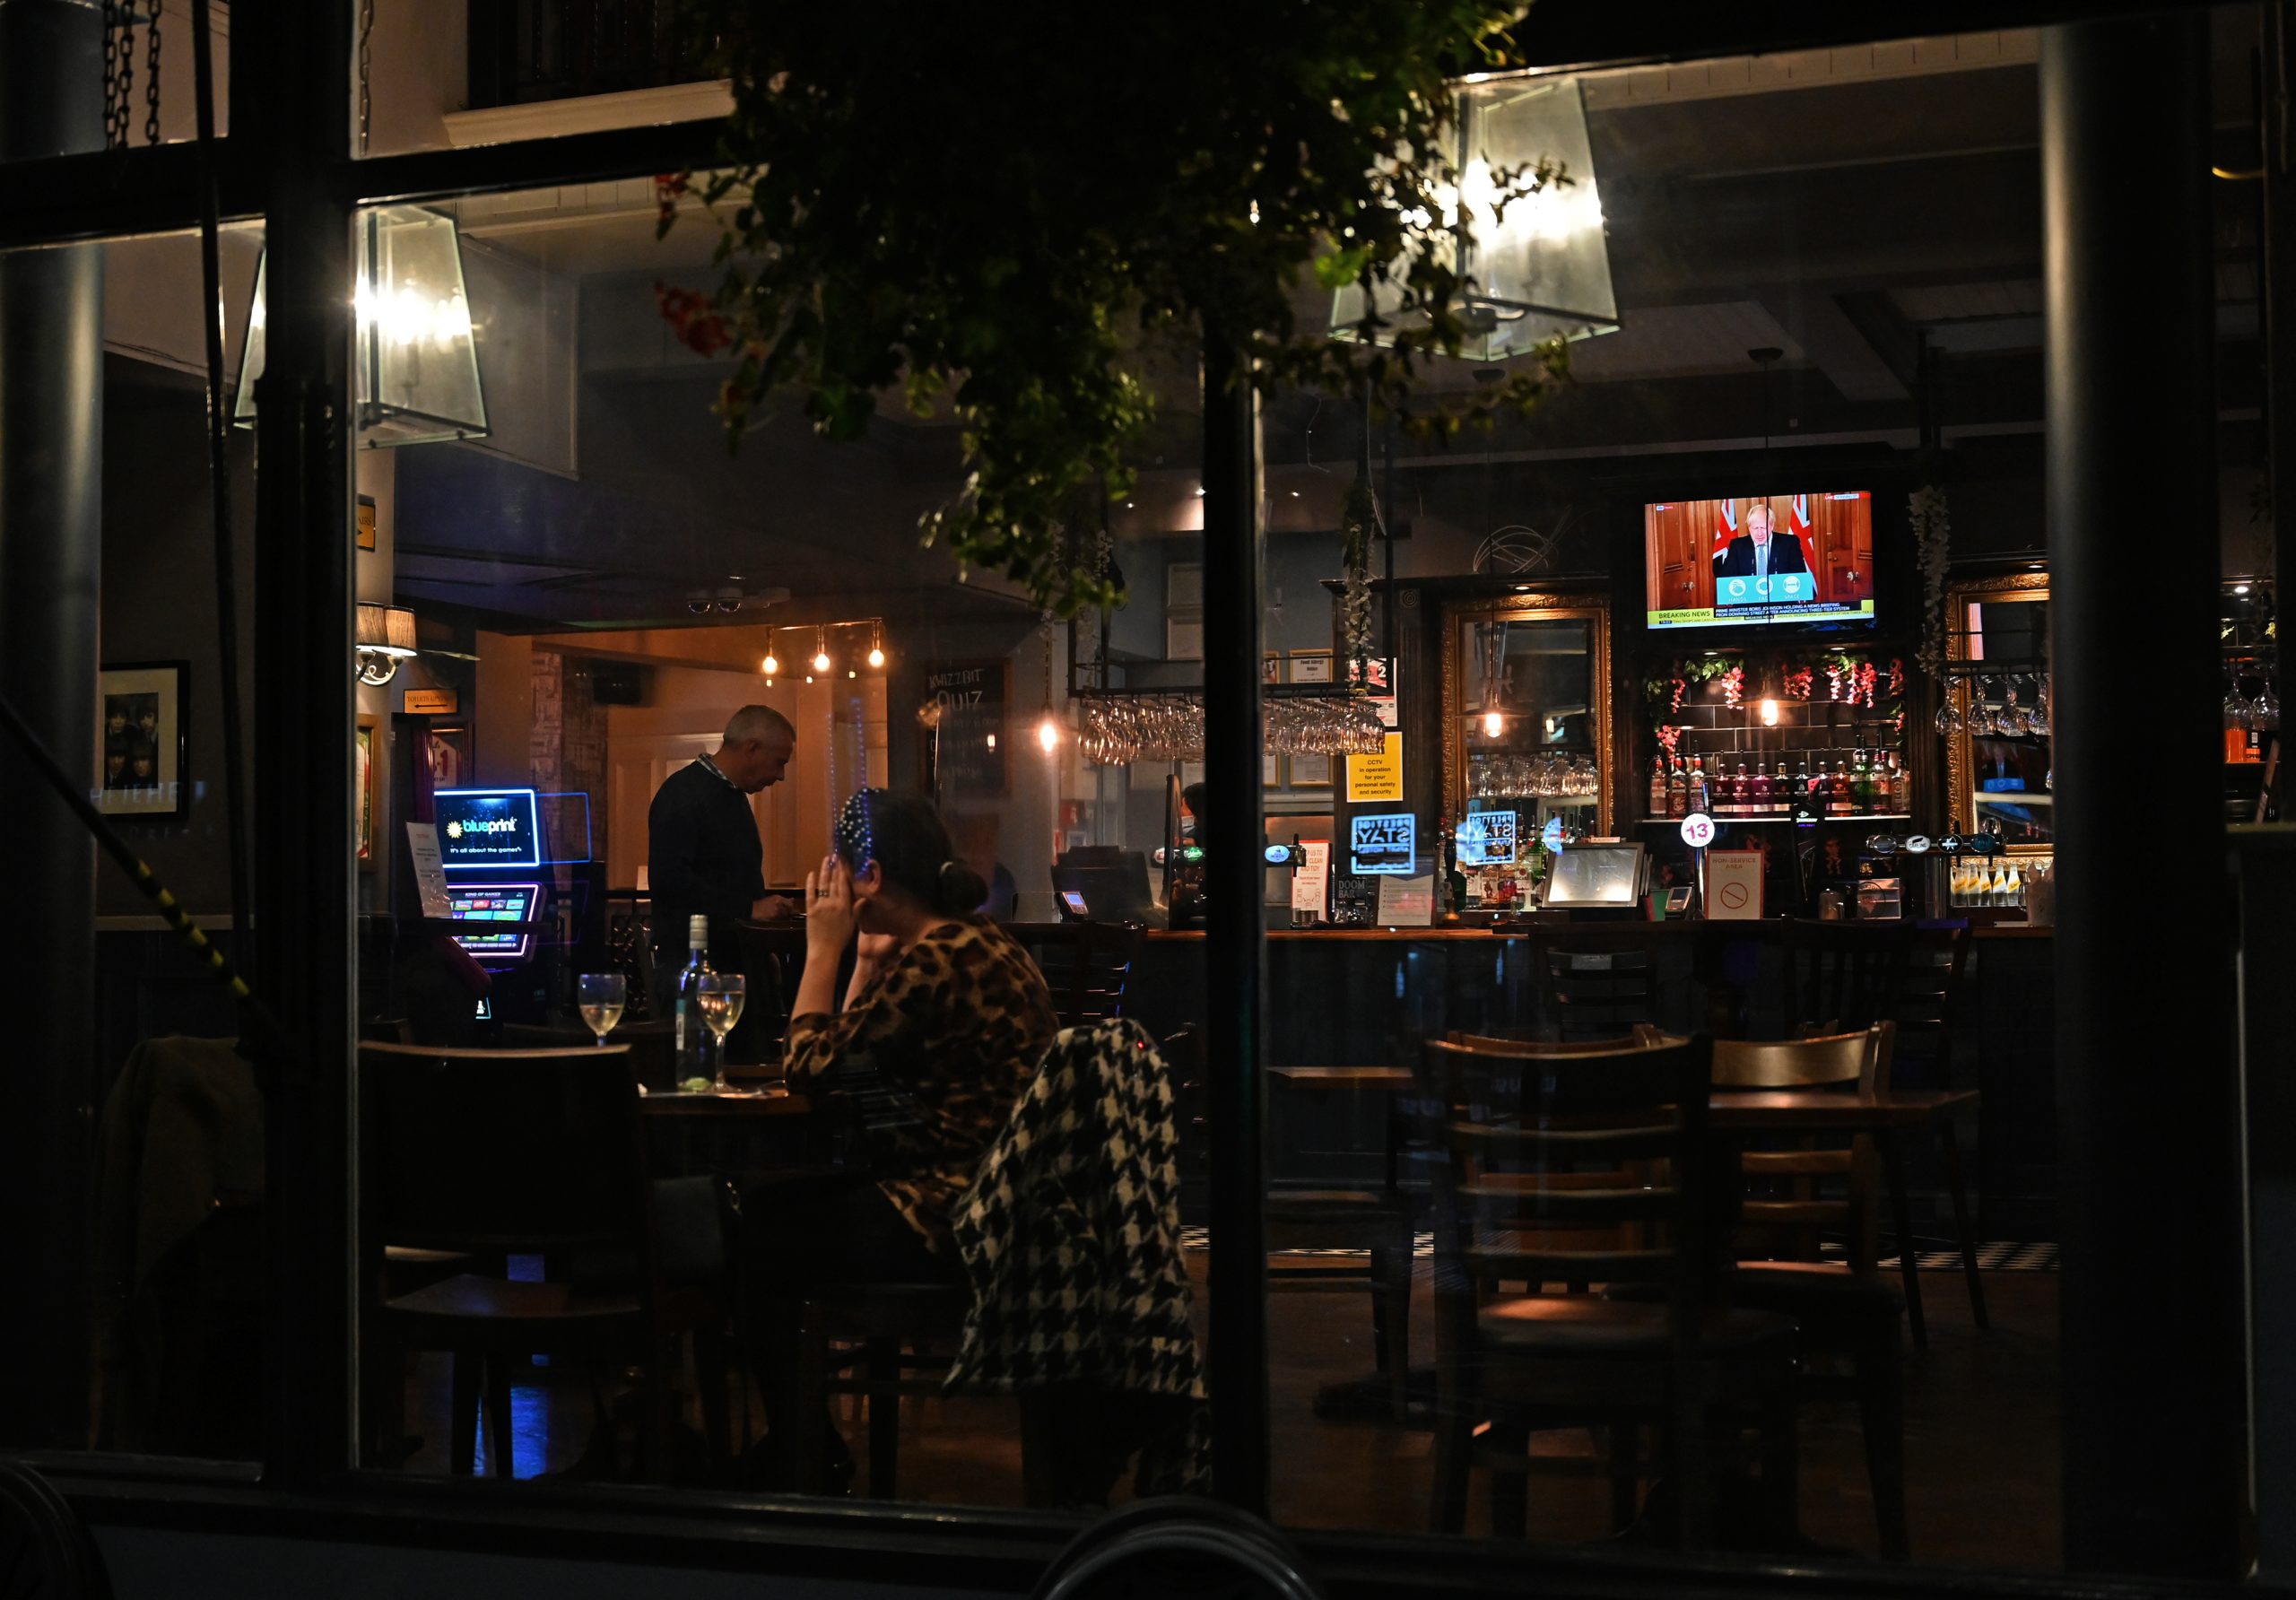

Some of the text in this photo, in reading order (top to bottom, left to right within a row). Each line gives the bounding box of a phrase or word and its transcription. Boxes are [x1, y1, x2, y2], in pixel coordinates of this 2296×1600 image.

[1378, 666, 1386, 678] 2
[937, 690, 984, 713] QUIZ
[462, 817, 516, 835] blueprint
[1686, 822, 1710, 839] 13
[1338, 880, 1365, 889] DOOM
[1338, 890, 1355, 898] BAR
